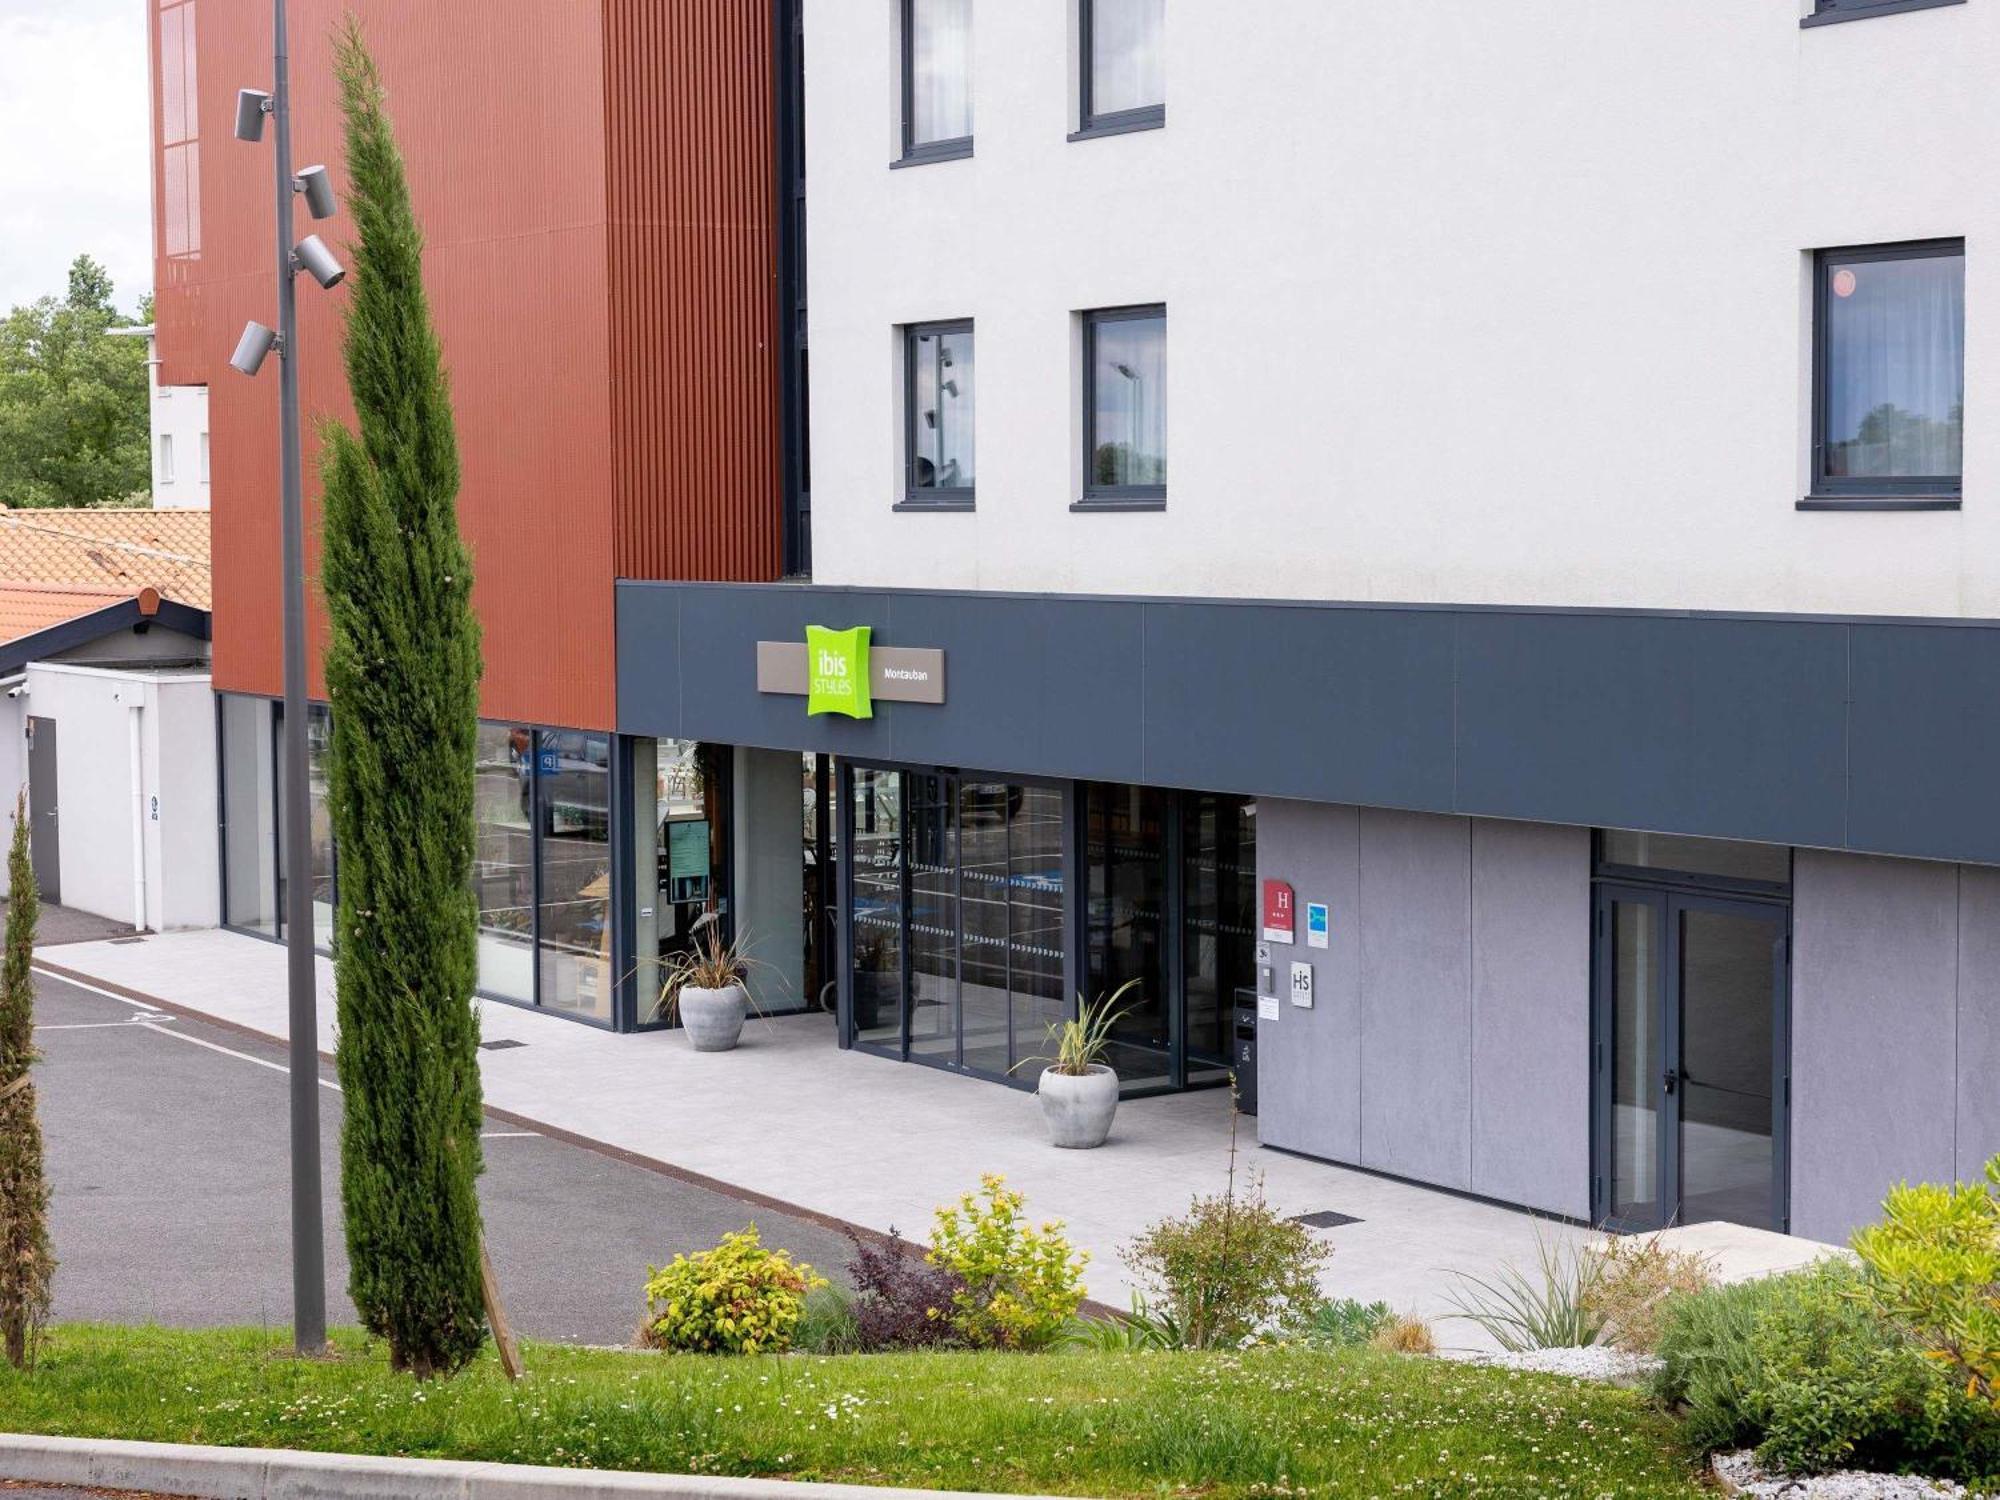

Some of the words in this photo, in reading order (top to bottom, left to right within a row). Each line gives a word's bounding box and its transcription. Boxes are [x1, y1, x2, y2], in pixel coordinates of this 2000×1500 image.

[818, 649, 847, 677] ibis
[884, 667, 928, 681] Montauban
[1277, 891, 1289, 909] H
